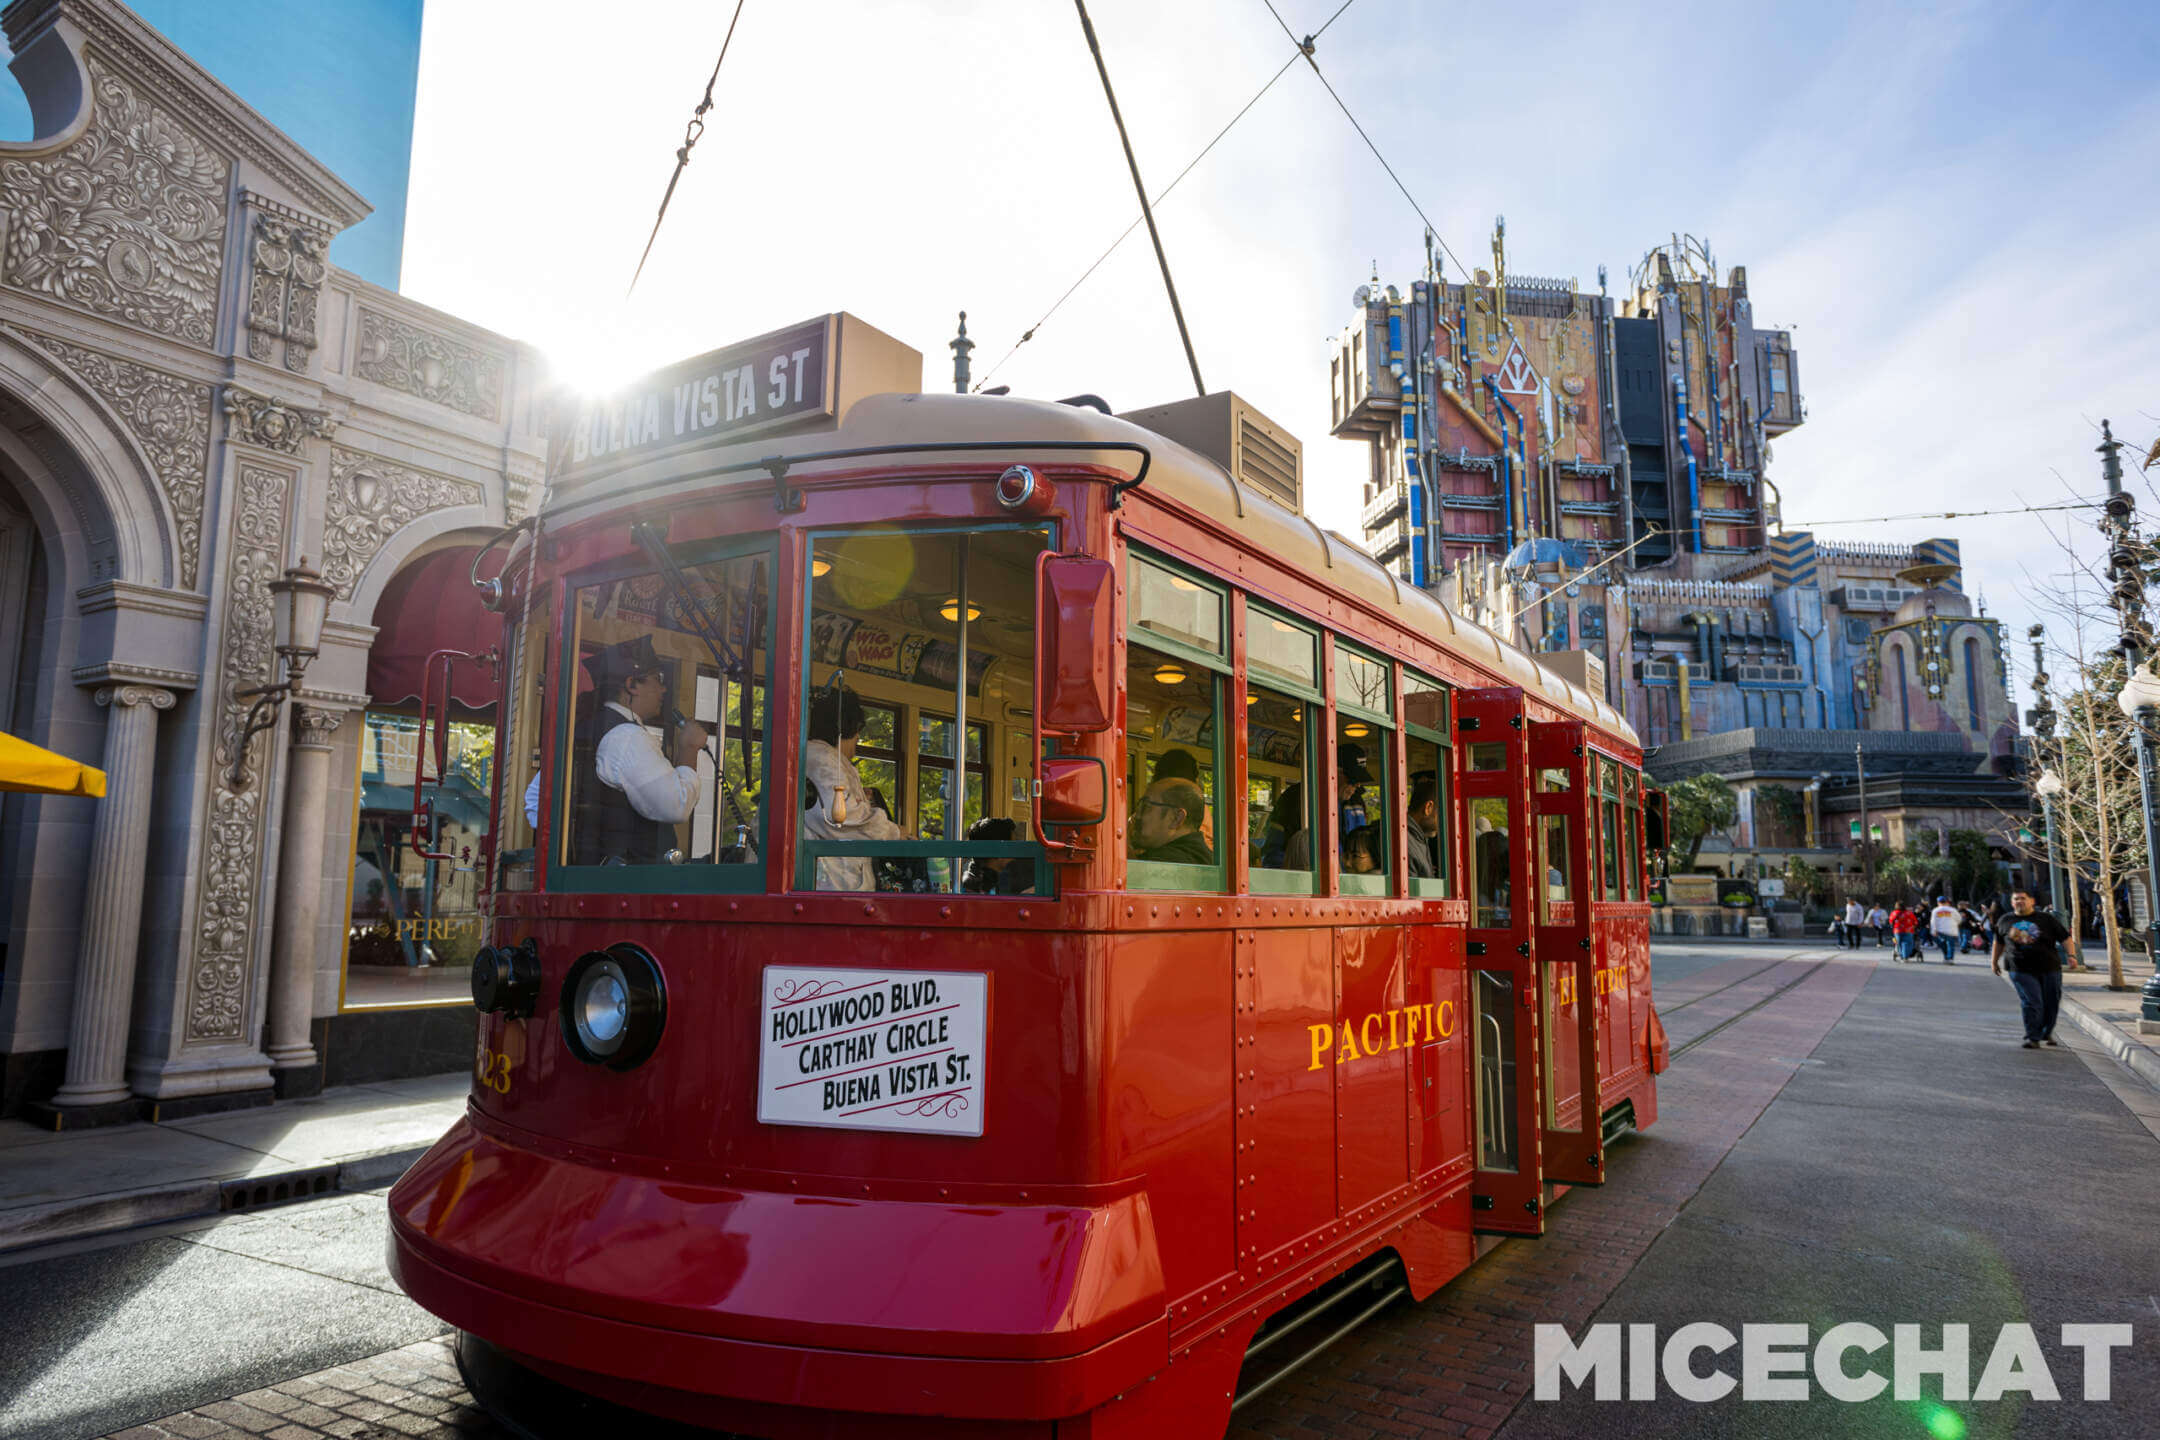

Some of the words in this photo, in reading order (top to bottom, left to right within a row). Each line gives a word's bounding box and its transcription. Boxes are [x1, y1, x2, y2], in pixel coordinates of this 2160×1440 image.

[673, 364, 756, 436] VISTA
[767, 347, 810, 410] ST
[772, 991, 884, 1042] HOLLYWOOD
[891, 979, 940, 1013] BLVD.
[1307, 1000, 1454, 1071] PACIFIC
[799, 1032, 878, 1075] CARTHAY
[886, 1016, 949, 1054] CIRCLE
[823, 1074, 881, 1111] BUENA
[889, 1062, 939, 1097] VISTA
[946, 1054, 971, 1086] ST.
